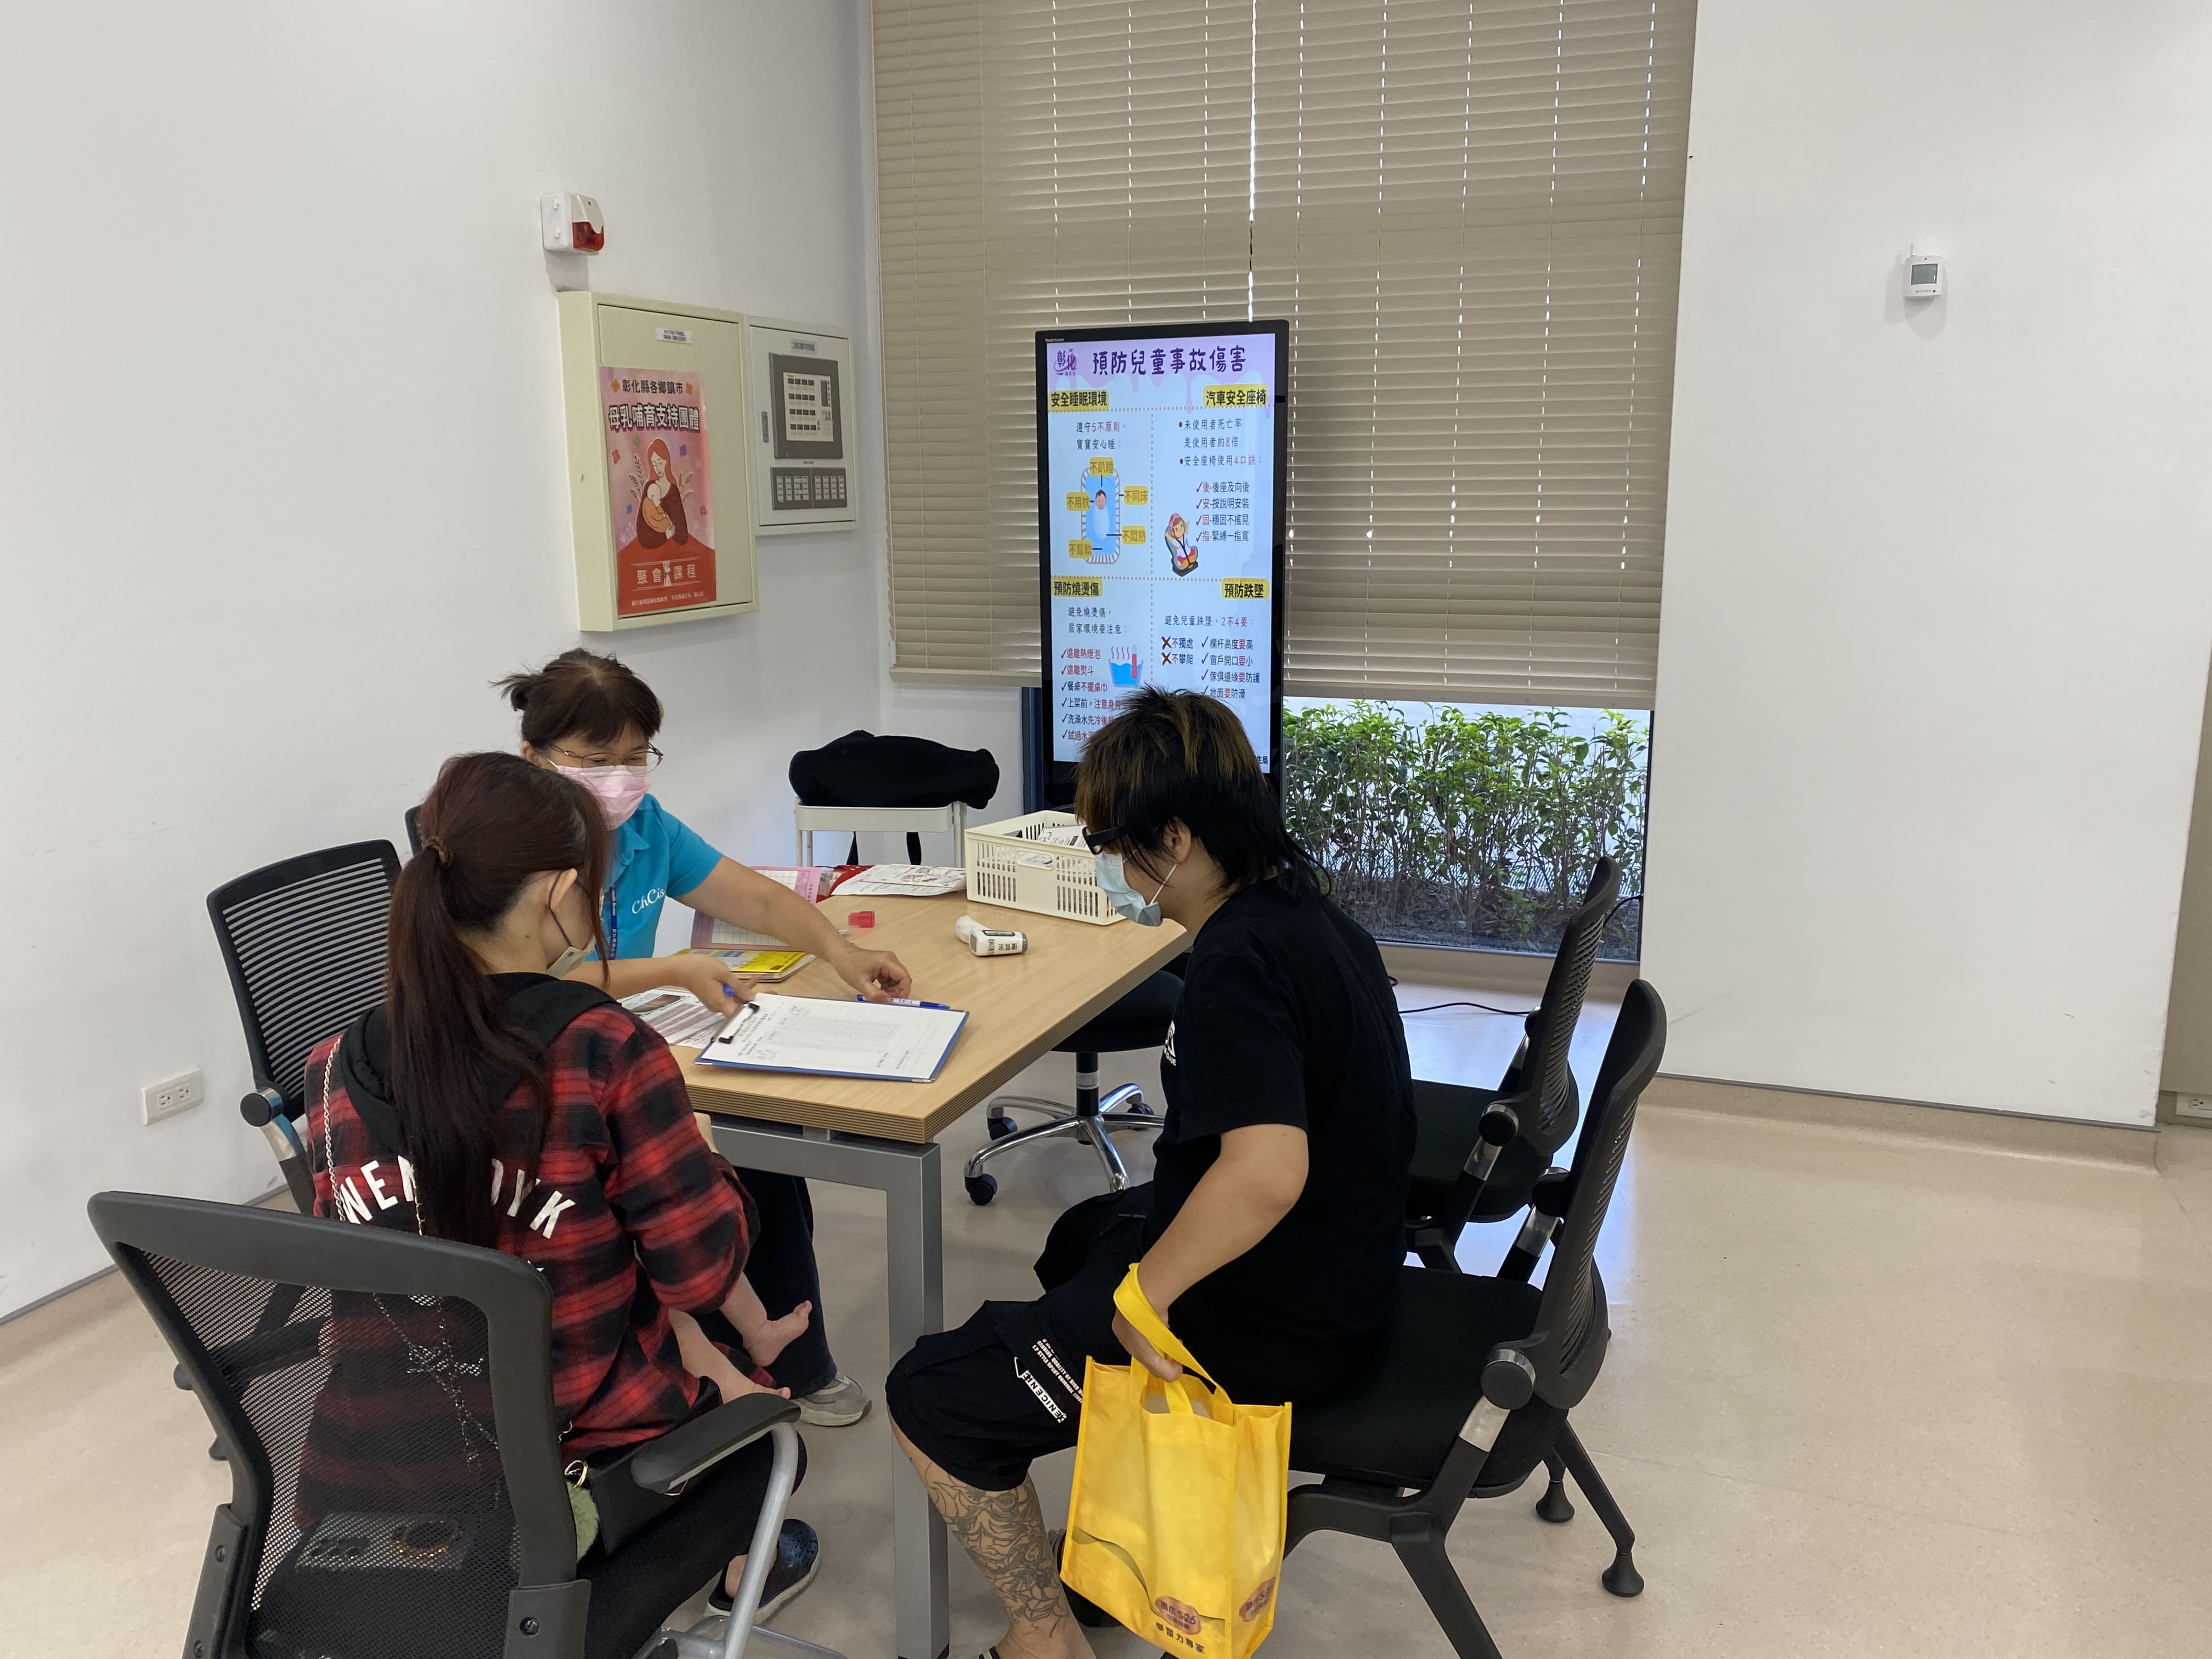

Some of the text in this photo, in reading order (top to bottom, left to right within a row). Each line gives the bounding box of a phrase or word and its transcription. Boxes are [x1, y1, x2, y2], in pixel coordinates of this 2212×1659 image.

[1092, 345, 1246, 375] 預防兒童事故傷害
[622, 379, 683, 394] 彰化縣各鄉鎮市
[1051, 391, 1107, 407] 安全睡眠環境
[1206, 388, 1267, 406] 汽車安全座椅
[608, 403, 701, 432] 母乳哺育支持團體
[1184, 417, 1242, 431] 未使用者死亡率
[1184, 437, 1239, 448] 是使用者的8倍
[1066, 496, 1090, 509] 不用枕
[1124, 490, 1148, 503] 不同床
[1122, 529, 1146, 542] 不悶熱
[1054, 582, 1099, 596] 預防燒燙傷
[1224, 583, 1263, 598] 預防跌墜
[1172, 637, 1193, 649] 不獨處
[1210, 637, 1253, 650] 欄杆高度要高
[1066, 648, 1101, 659] 遠離熱燈泡
[1172, 653, 1193, 665] 不攀爬
[1210, 654, 1253, 667] 窗戶開口要小
[1066, 664, 1094, 675] 遠離熨斗
[1210, 671, 1260, 684] 傢俱邊緣要防護
[1210, 687, 1245, 699] 地面要防滑
